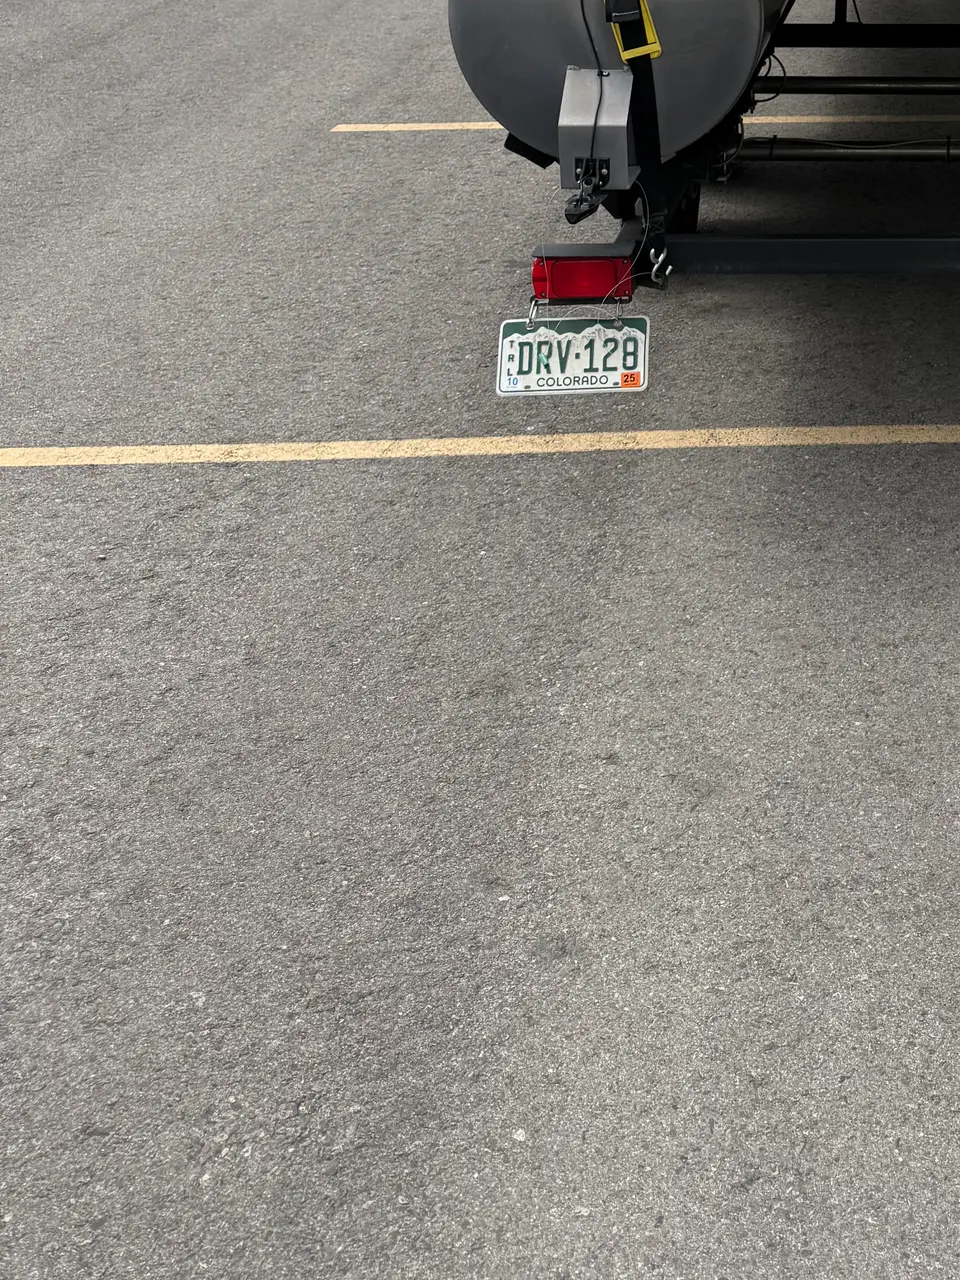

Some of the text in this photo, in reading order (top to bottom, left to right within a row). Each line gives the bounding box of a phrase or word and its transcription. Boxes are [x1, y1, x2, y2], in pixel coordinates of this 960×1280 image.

[507, 377, 519, 386] 10
[536, 375, 609, 388] COLORADO
[623, 373, 636, 384] 25
